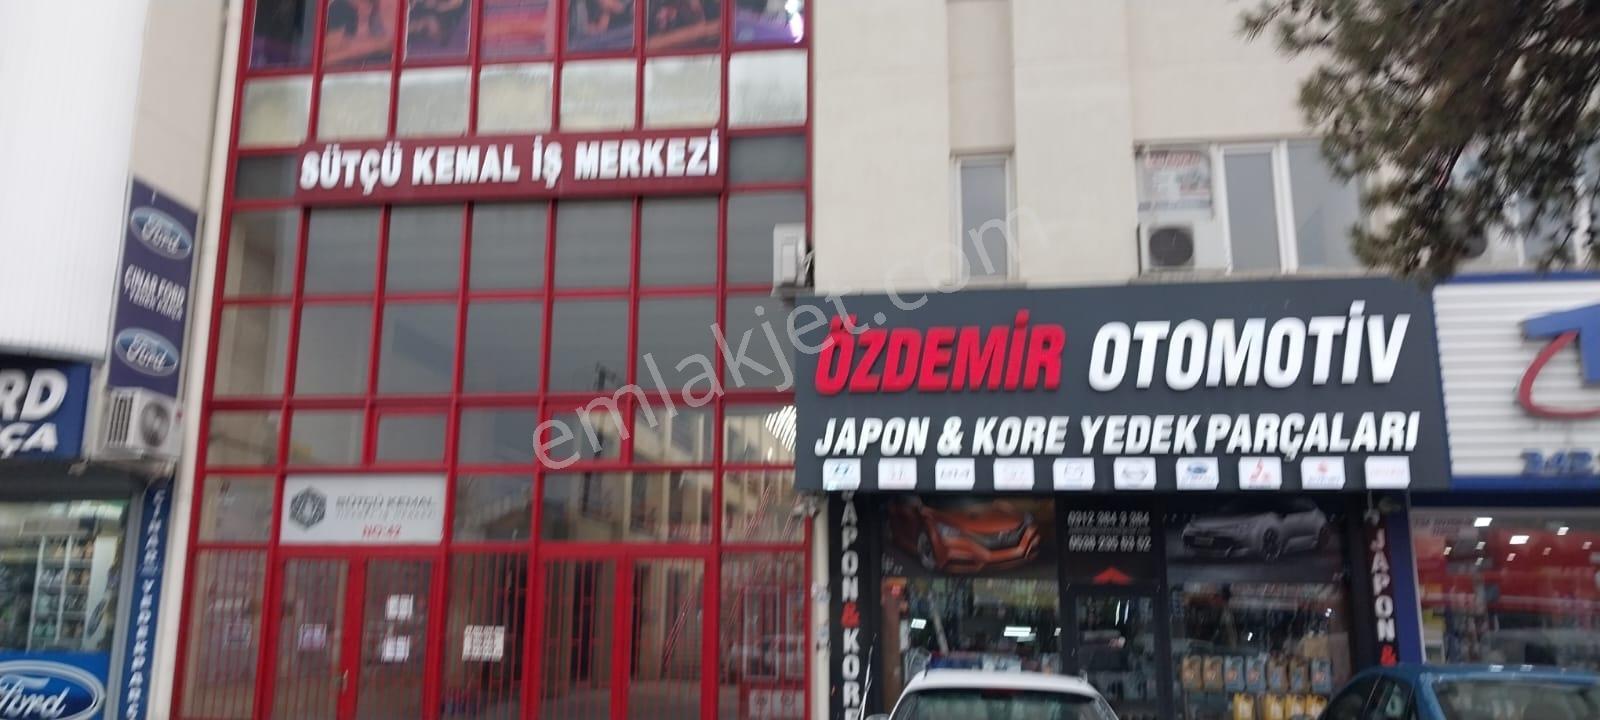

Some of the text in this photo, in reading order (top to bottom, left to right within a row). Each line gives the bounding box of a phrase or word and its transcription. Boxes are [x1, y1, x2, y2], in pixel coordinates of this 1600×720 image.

[300, 129, 719, 195] SÜTÇÜ KEMAL İŞ MERKEZİ
[815, 300, 1411, 395] ÖZDEMİR OTOMOTİV
[814, 411, 1420, 462] JAPON & KORE YEDEK PARÇALARI
[840, 602, 860, 628] &
[1371, 528, 1395, 642] JAPON
